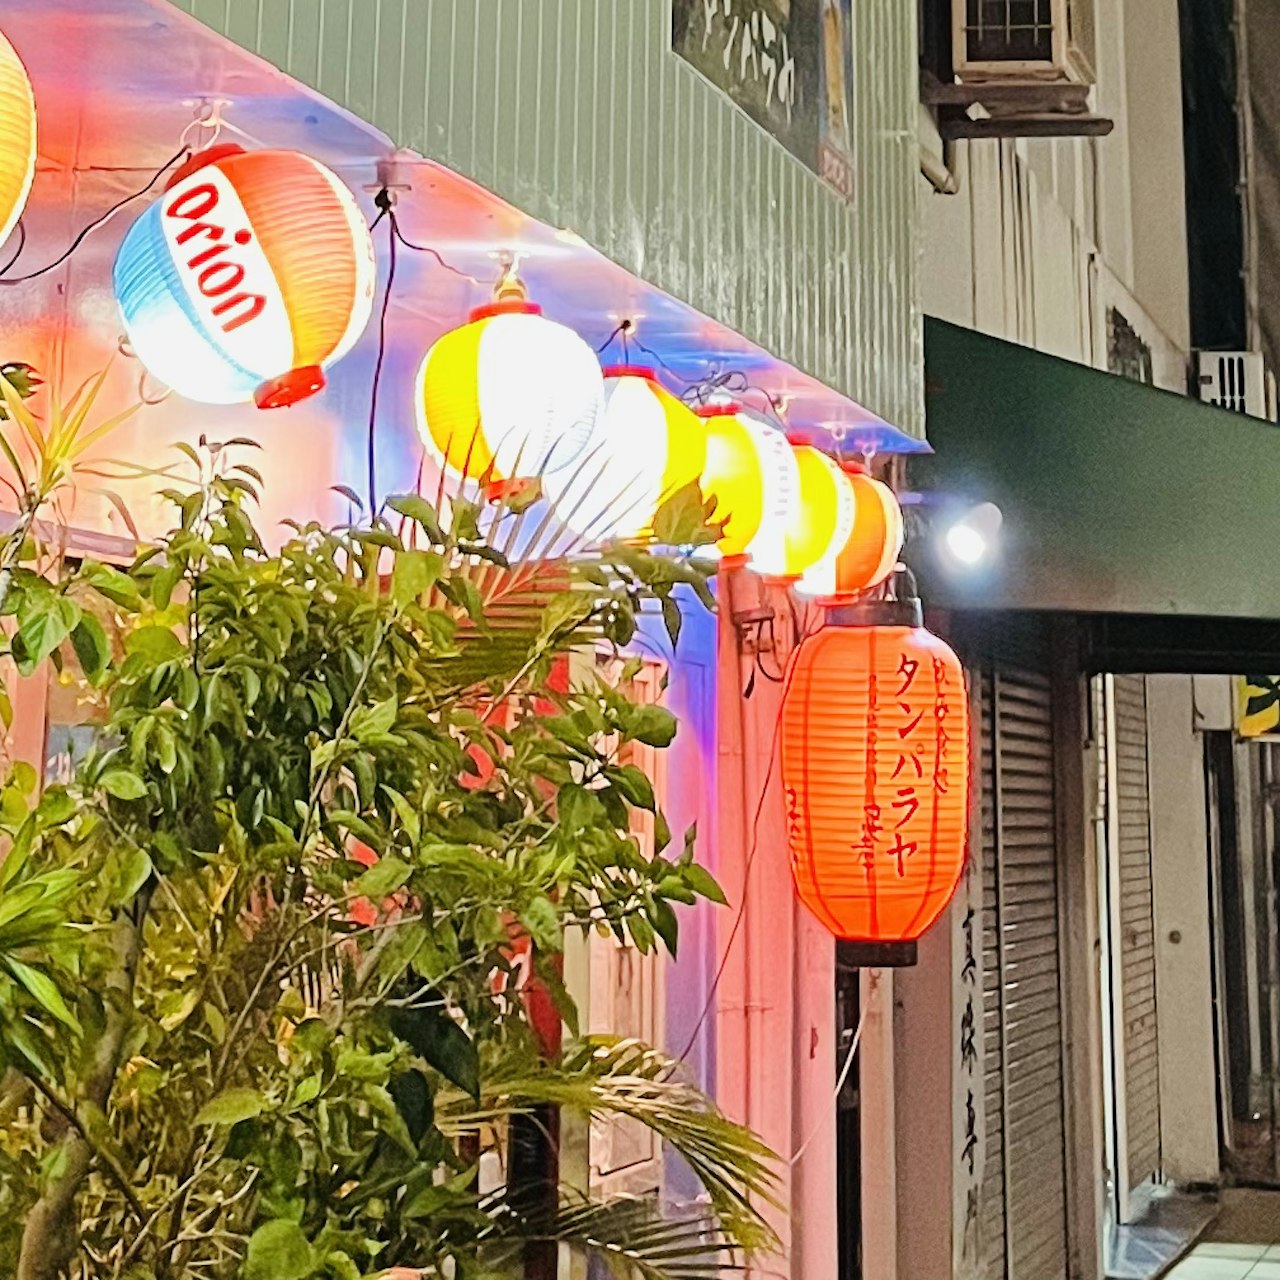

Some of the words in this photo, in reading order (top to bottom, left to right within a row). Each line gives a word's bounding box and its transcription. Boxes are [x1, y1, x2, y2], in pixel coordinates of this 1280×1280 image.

[886, 652, 926, 878] タンパラヤ
